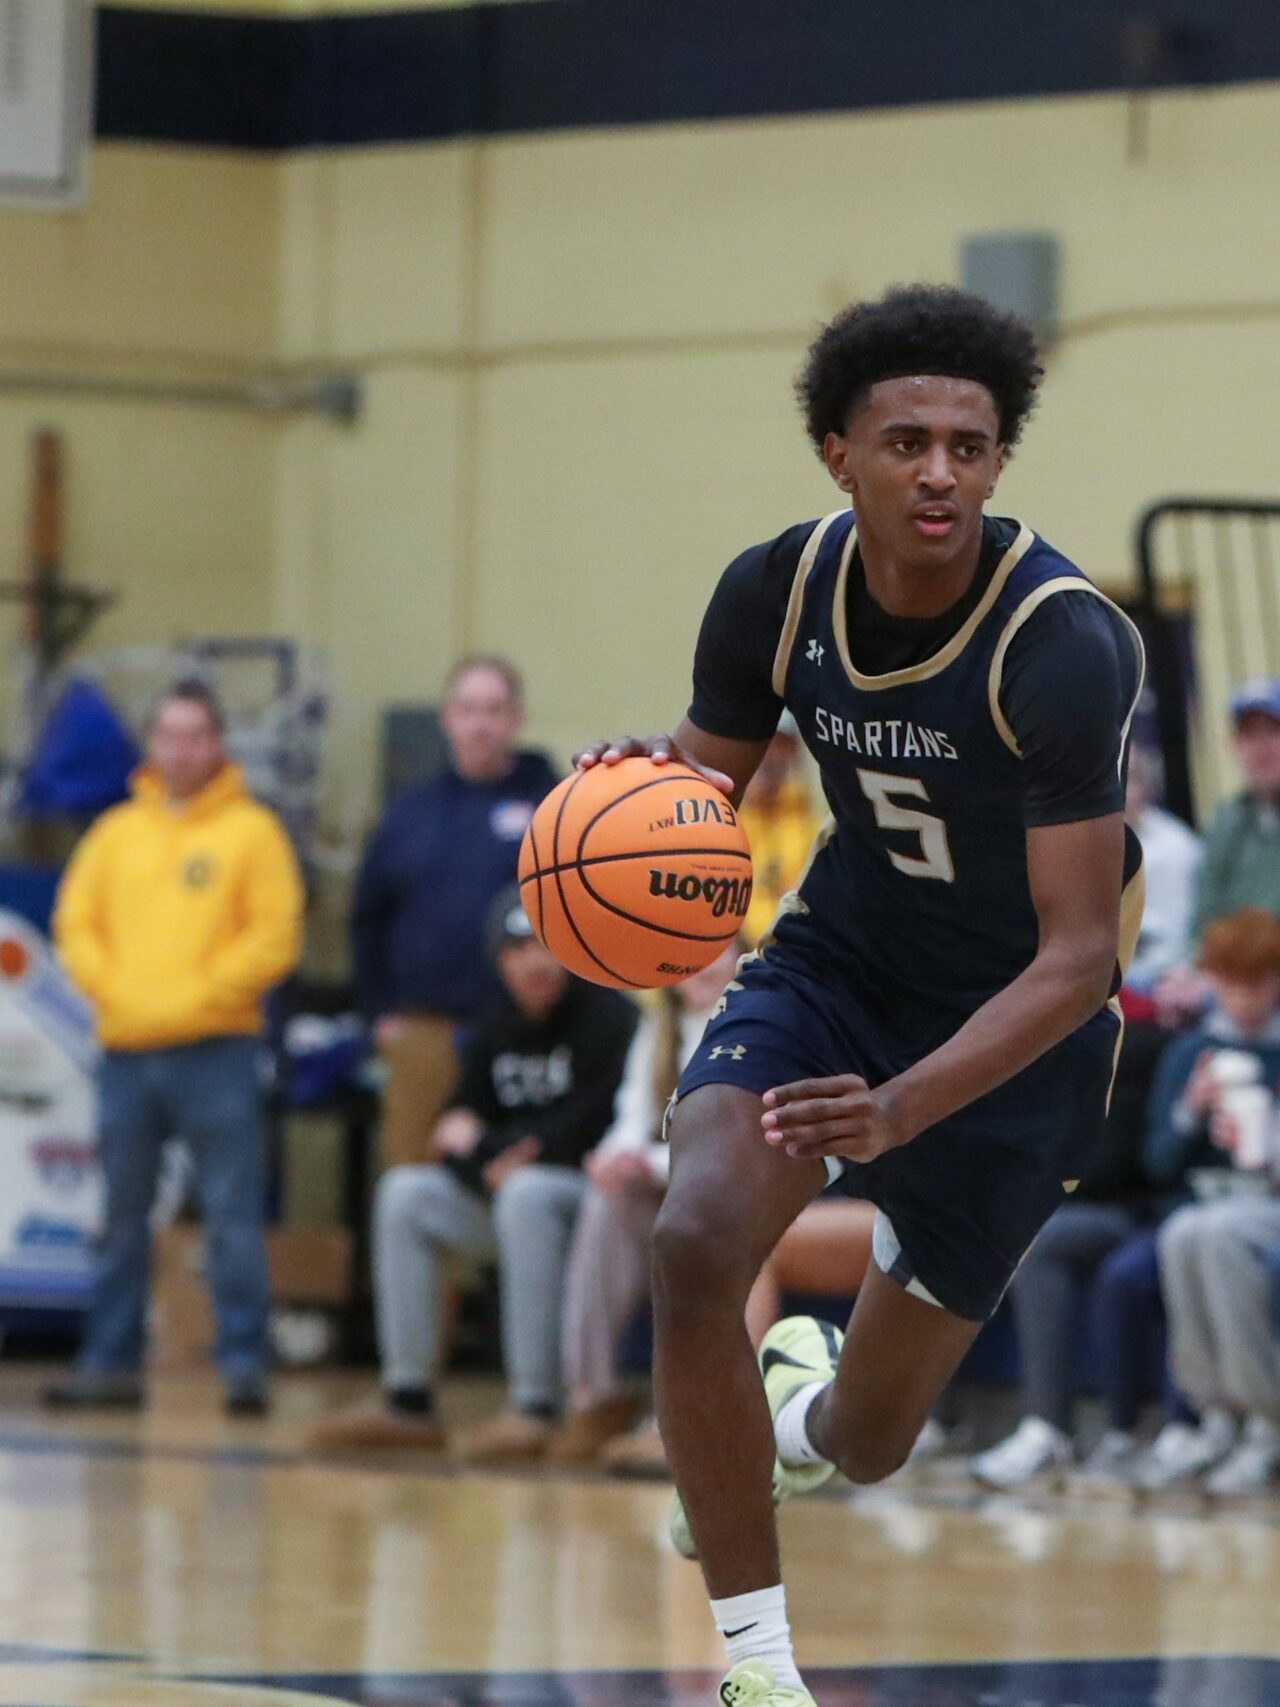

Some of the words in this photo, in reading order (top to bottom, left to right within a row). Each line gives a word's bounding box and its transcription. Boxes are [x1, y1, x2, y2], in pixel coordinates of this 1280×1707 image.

[815, 706, 959, 761] SPARTANS
[675, 799, 738, 828] EVO
[856, 768, 955, 883] 5
